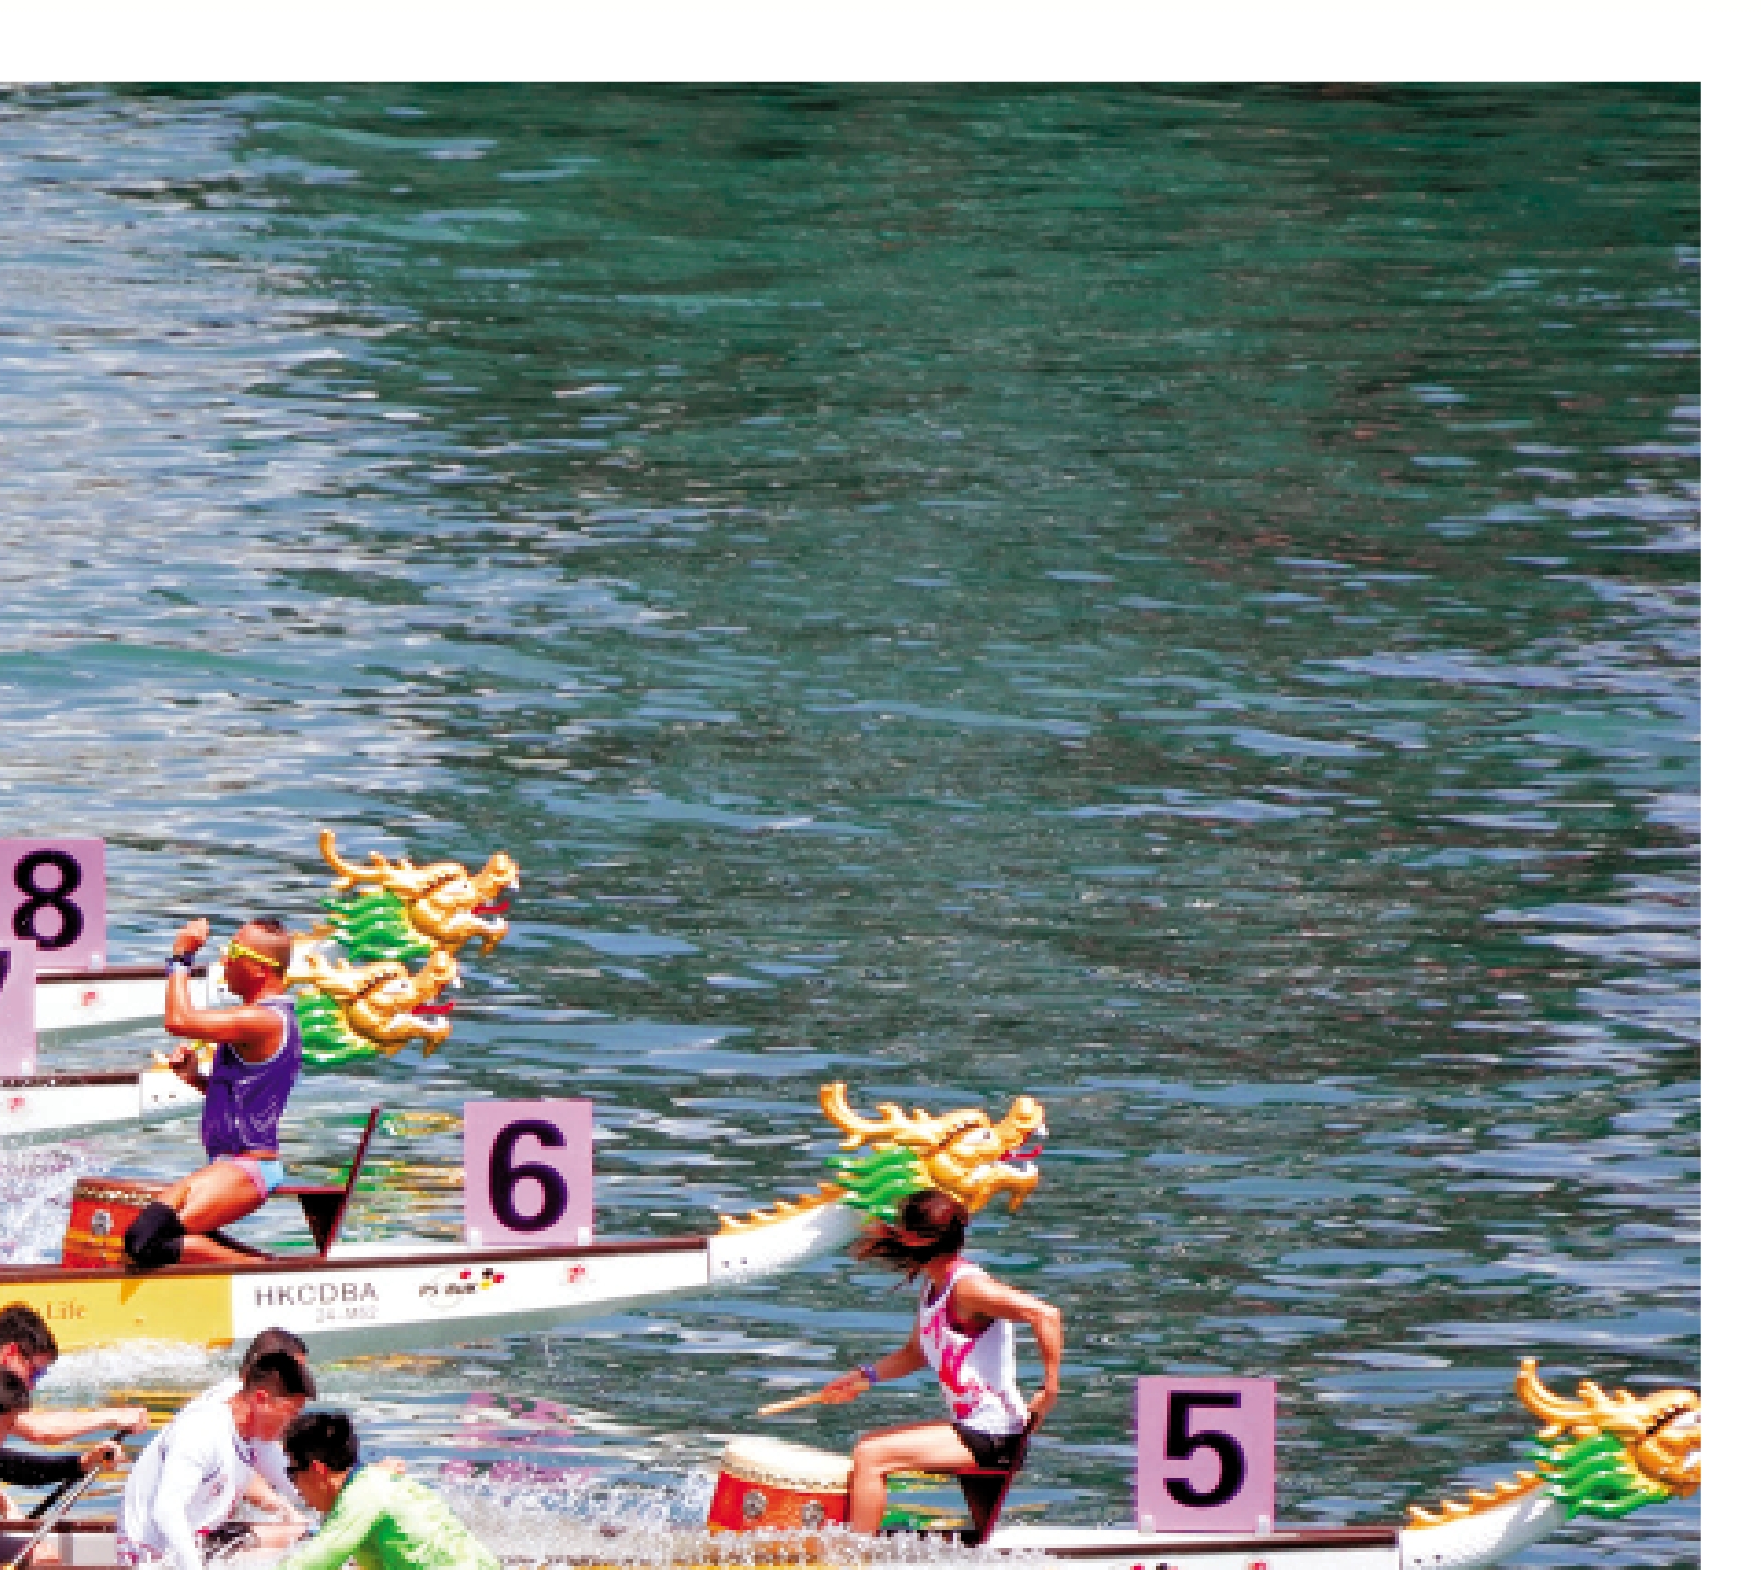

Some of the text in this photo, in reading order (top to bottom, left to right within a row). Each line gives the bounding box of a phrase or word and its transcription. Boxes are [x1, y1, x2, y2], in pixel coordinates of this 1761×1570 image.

[12, 849, 84, 950] 8
[488, 1119, 569, 1232] 6
[254, 1283, 379, 1307] HKCDBA
[1164, 1391, 1244, 1508] 5
